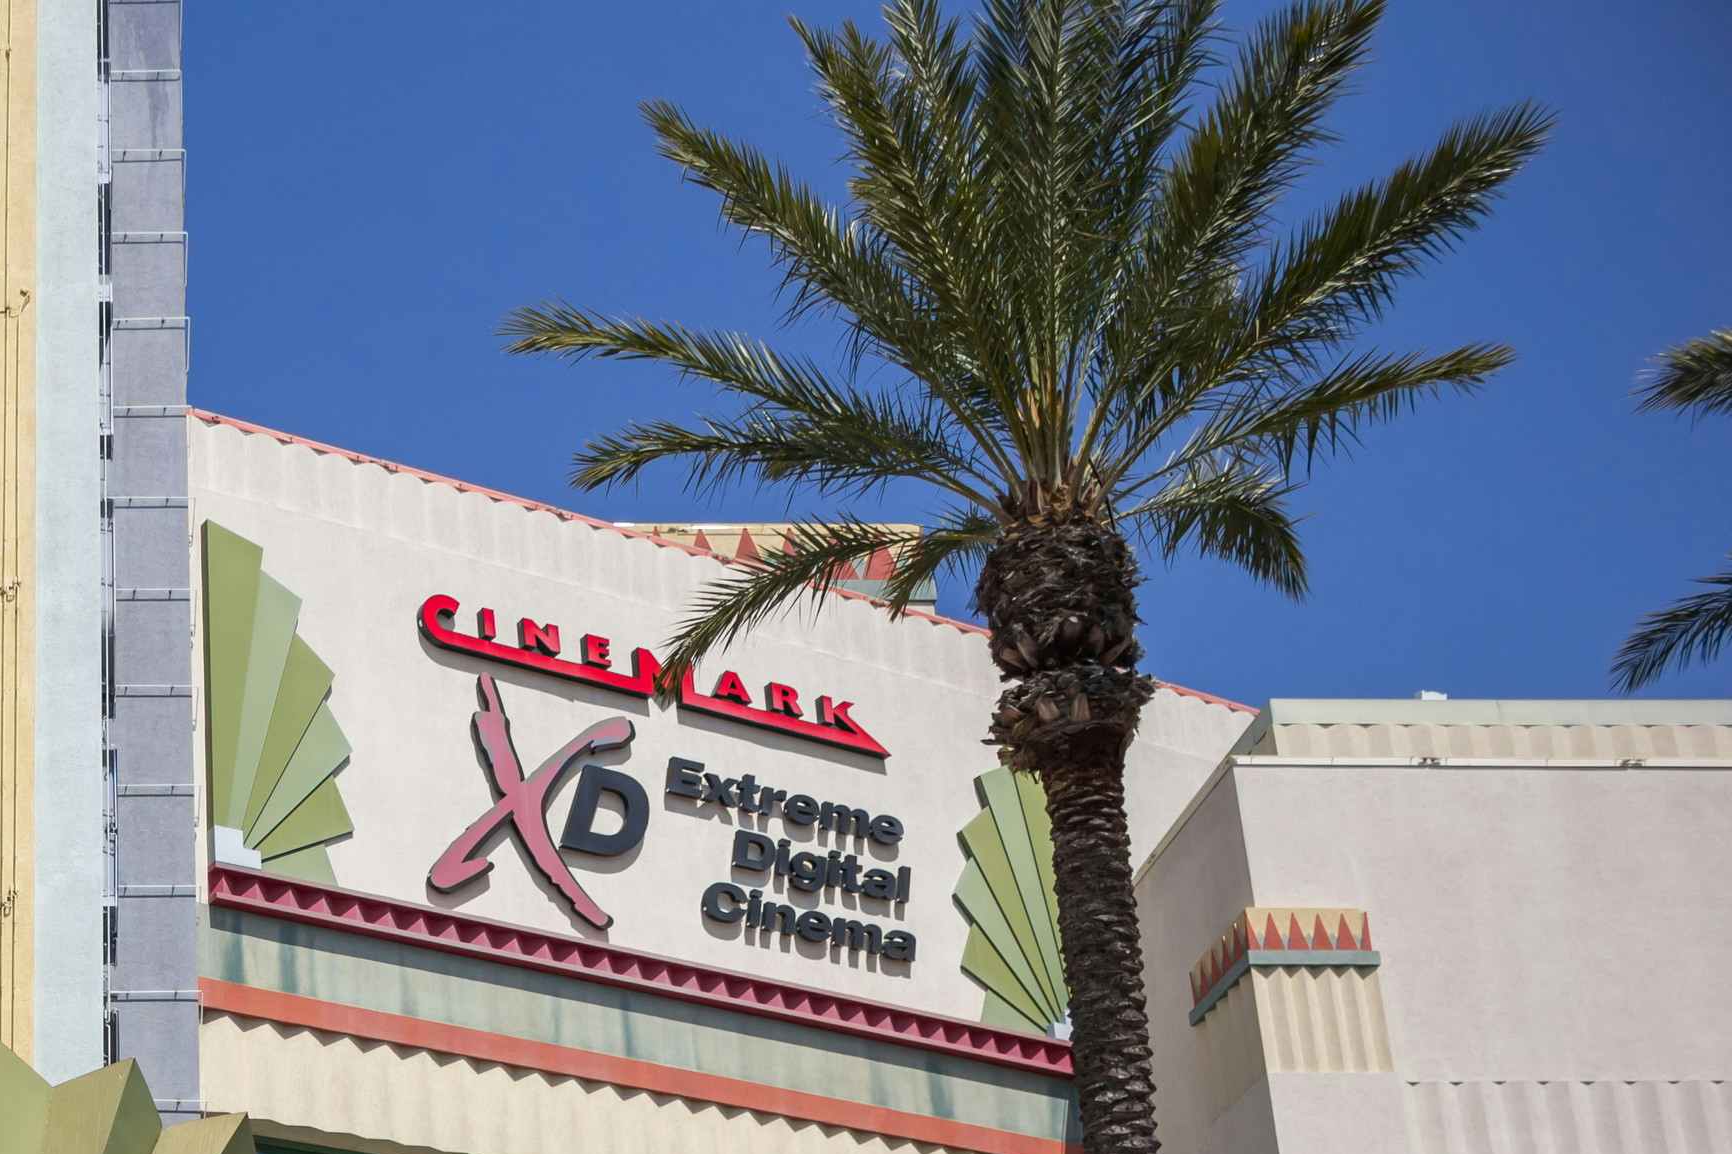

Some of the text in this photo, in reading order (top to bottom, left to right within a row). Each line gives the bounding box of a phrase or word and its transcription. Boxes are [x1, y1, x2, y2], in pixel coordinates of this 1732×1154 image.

[427, 672, 649, 930] XD
[665, 756, 905, 846] Extreme
[732, 830, 910, 904] Digital
[702, 881, 917, 963] Cinema
